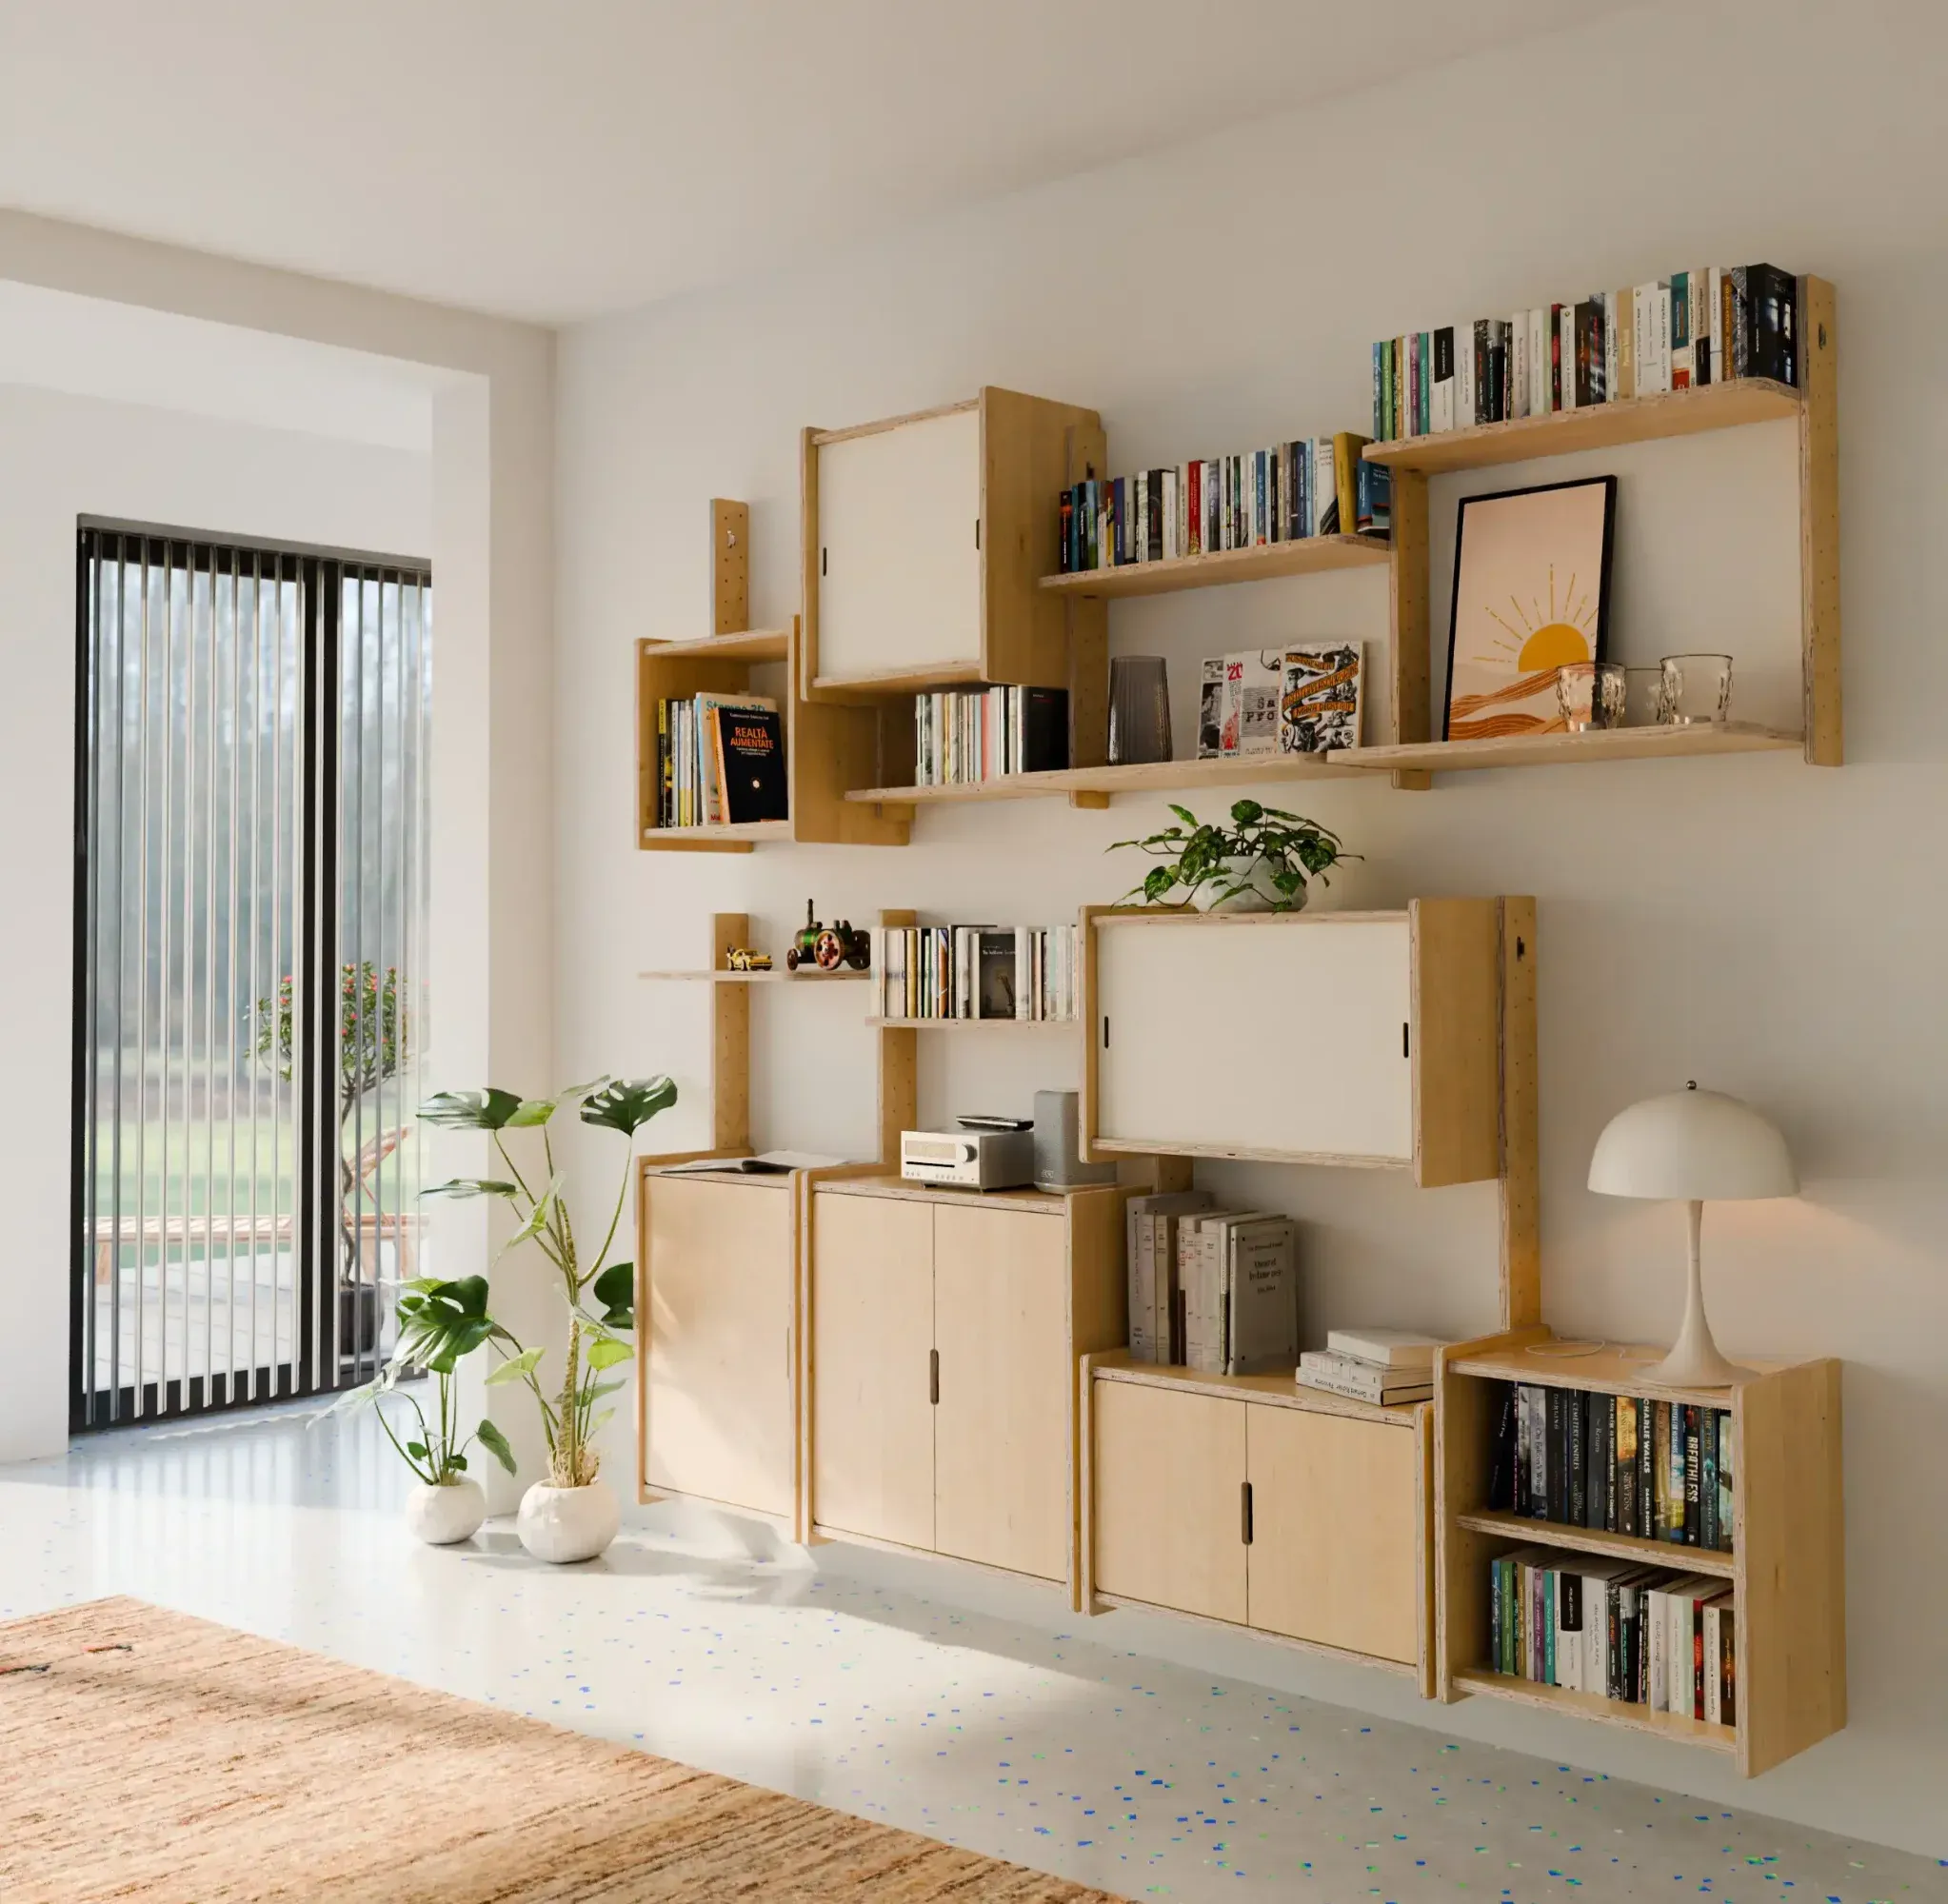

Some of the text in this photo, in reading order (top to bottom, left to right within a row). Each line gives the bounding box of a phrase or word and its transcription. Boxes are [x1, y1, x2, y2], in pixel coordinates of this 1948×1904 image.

[730, 738, 774, 749] AUMENTATE
[735, 726, 767, 739] REALTÀ
[1594, 1427, 1604, 1454] Return
[1642, 1440, 1651, 1474] WALKS
[1686, 1436, 1699, 1503] BREATHLESS
[1534, 1471, 1543, 1495] Wings
